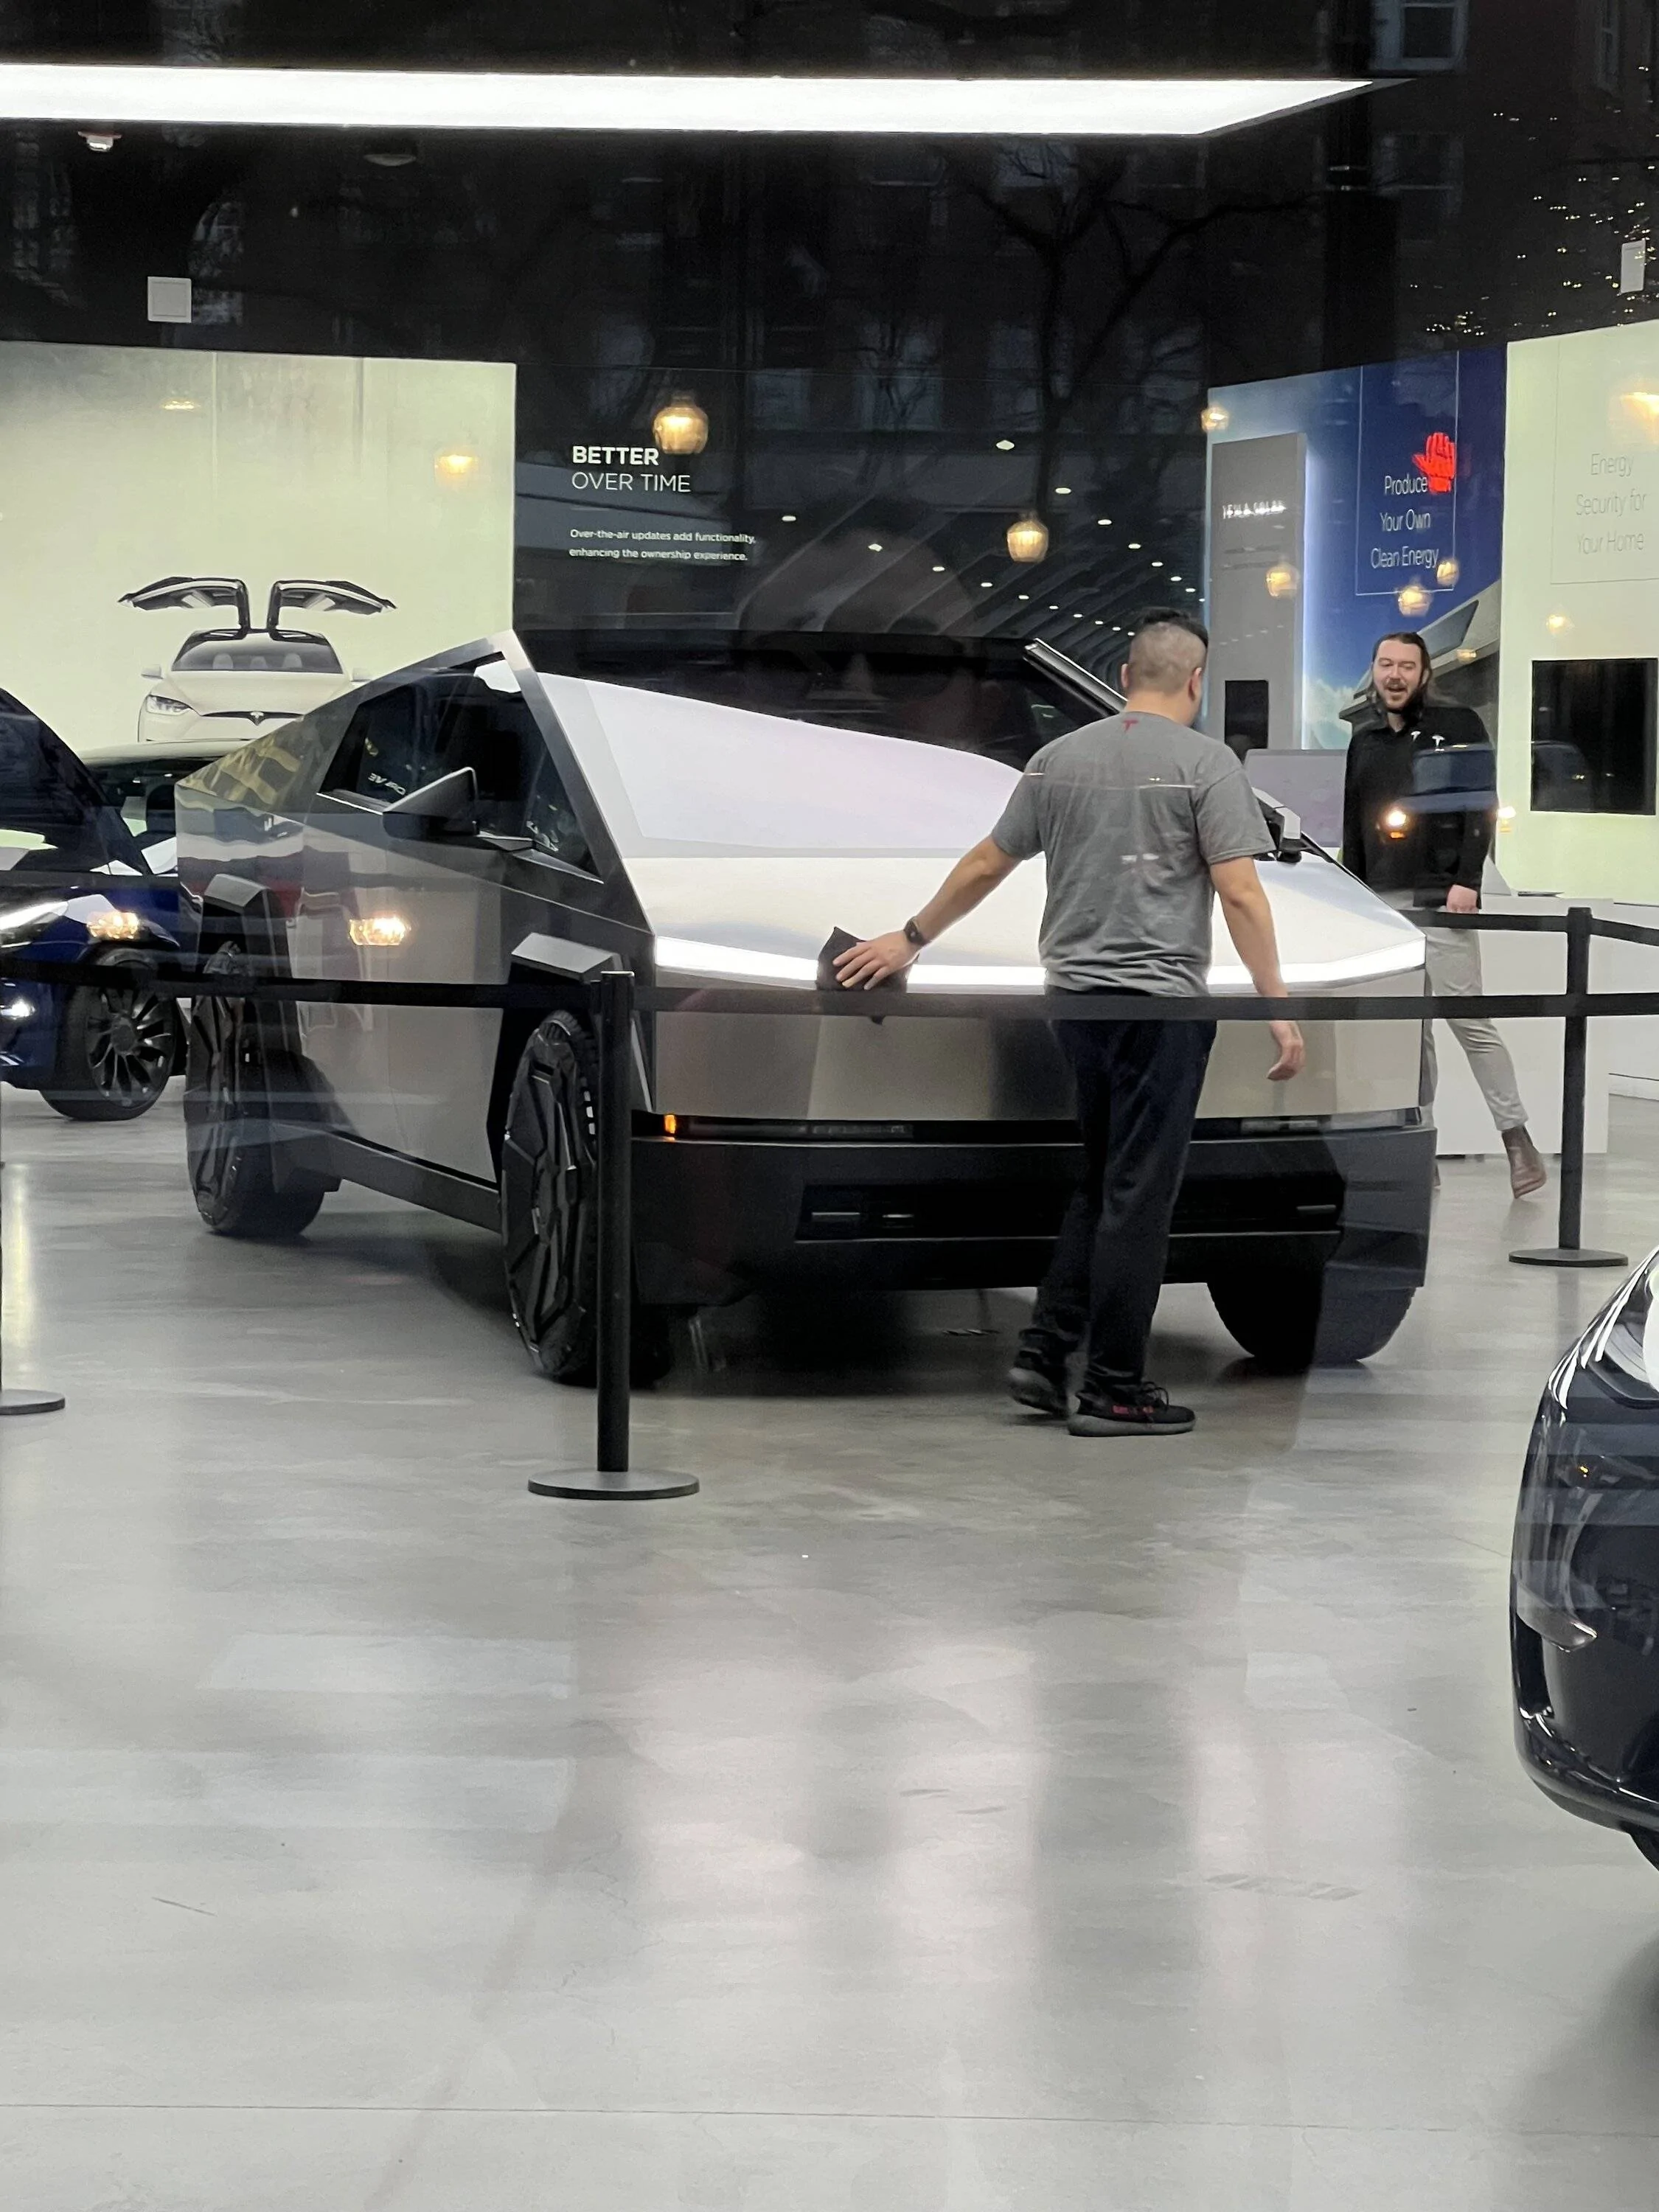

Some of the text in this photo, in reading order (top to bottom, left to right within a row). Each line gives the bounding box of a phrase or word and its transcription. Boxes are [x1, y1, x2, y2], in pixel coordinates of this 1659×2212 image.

[572, 445, 658, 465] BETTER
[1590, 453, 1634, 477] Energy
[571, 471, 691, 492] OVER TIME
[1384, 473, 1427, 495] Produce
[1576, 488, 1649, 518] Security for
[1380, 509, 1431, 532] Your Own
[570, 529, 629, 539] Over-the-air
[632, 531, 671, 541] updates
[673, 532, 692, 541] add
[1607, 530, 1644, 552] Home
[569, 548, 748, 561] enhancing the ownership experience.
[1371, 546, 1439, 569] Clean Energy
